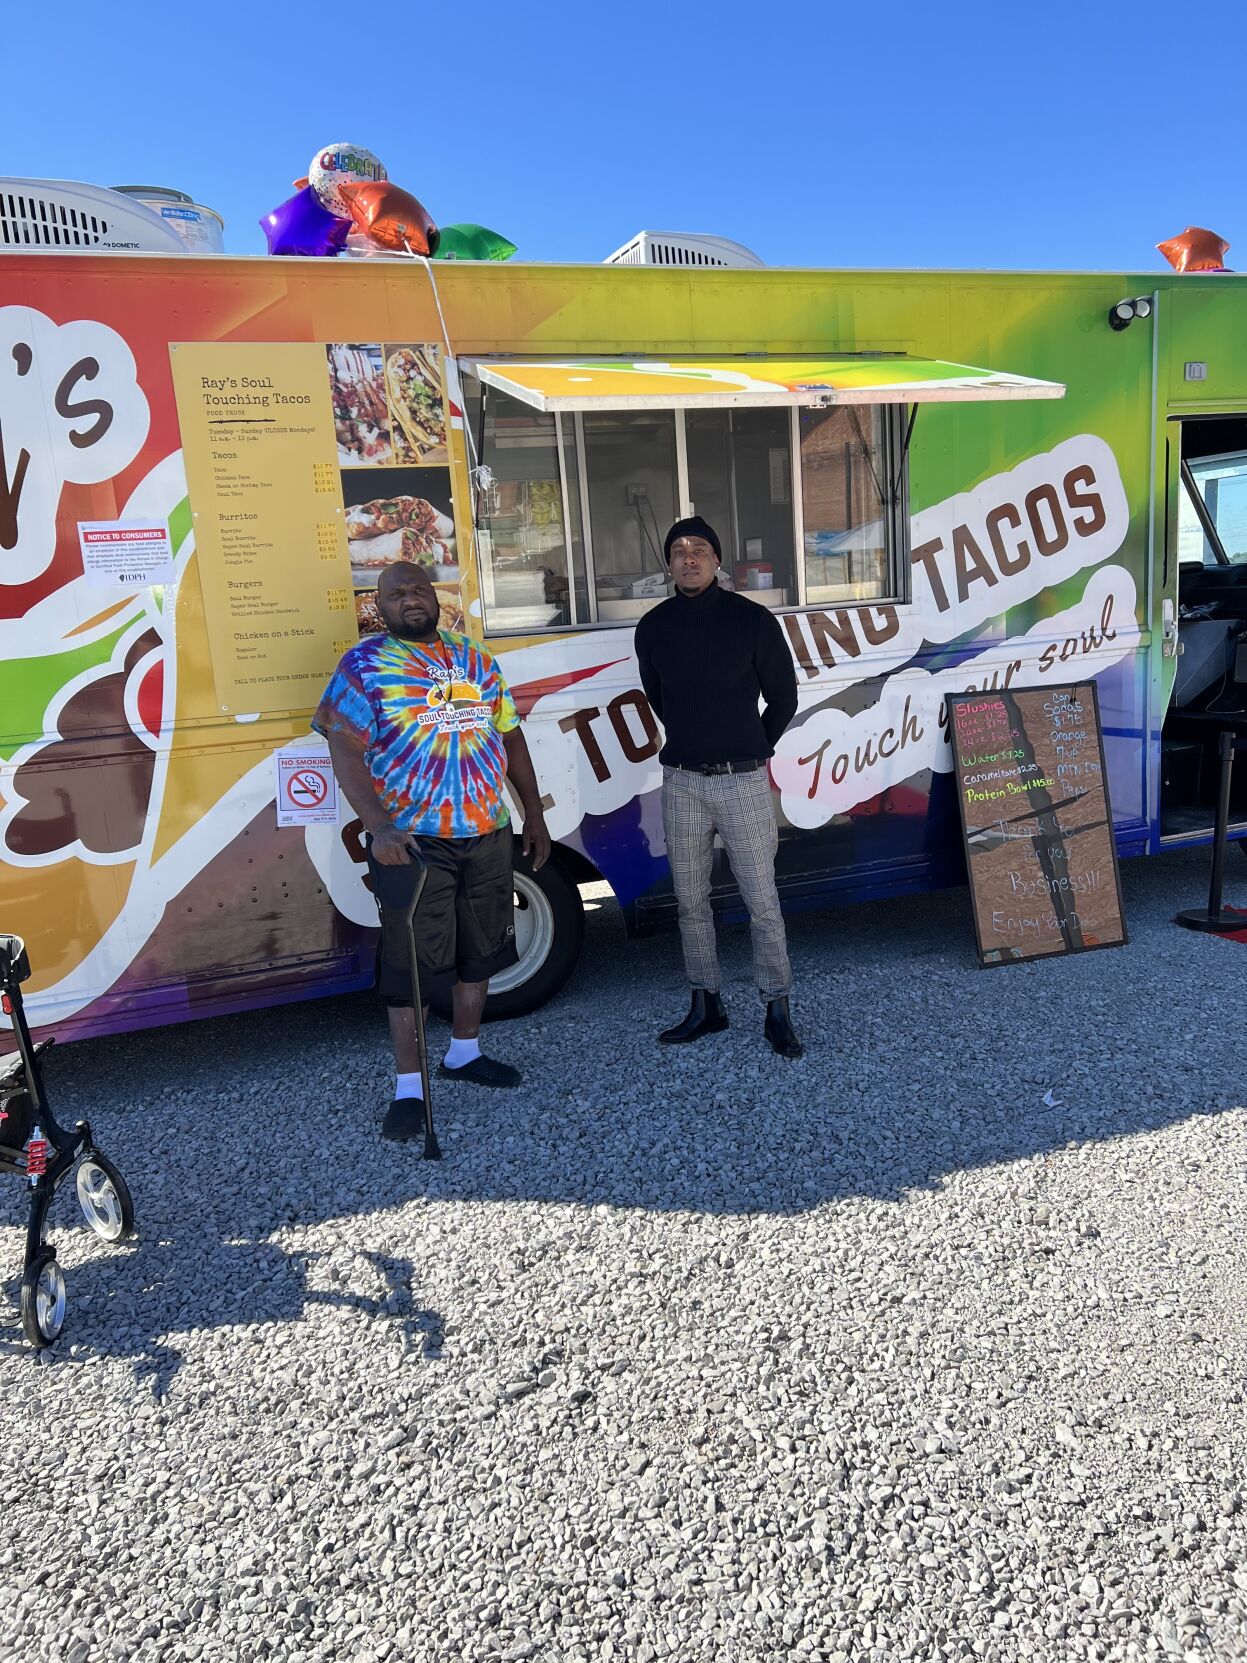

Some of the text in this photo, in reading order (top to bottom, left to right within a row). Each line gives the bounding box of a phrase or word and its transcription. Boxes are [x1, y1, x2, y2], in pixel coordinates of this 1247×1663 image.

[201, 377, 274, 390] Ray's Soul
[203, 393, 311, 407] Touching Tacos
[208, 428, 234, 436] Tuesday
[219, 512, 258, 521] Burritos
[87, 533, 110, 541] NOTICE
[121, 531, 162, 540] CONSUMERS
[911, 464, 1106, 612] TACOS
[228, 580, 263, 589] Burgers
[234, 631, 269, 640] Chicken
[291, 628, 315, 636] Stick
[797, 694, 924, 800] Touch
[1038, 593, 1117, 673] soul
[1052, 693, 1070, 704] Can
[956, 701, 1006, 717] Slushies
[1043, 703, 1084, 718] Sodas
[418, 713, 440, 724] SOUL
[1053, 714, 1082, 728] $1.75
[439, 722, 459, 732] Touch
[1050, 730, 1087, 743] Orange
[961, 753, 1000, 767] Water
[963, 770, 1000, 786] Caramel
[965, 788, 1006, 804] Protein
[1006, 780, 1031, 795] Bowl
[1060, 779, 1088, 799] Pepsi
[1007, 870, 1100, 897] Business!!!
[992, 911, 1040, 939] Enjoy
